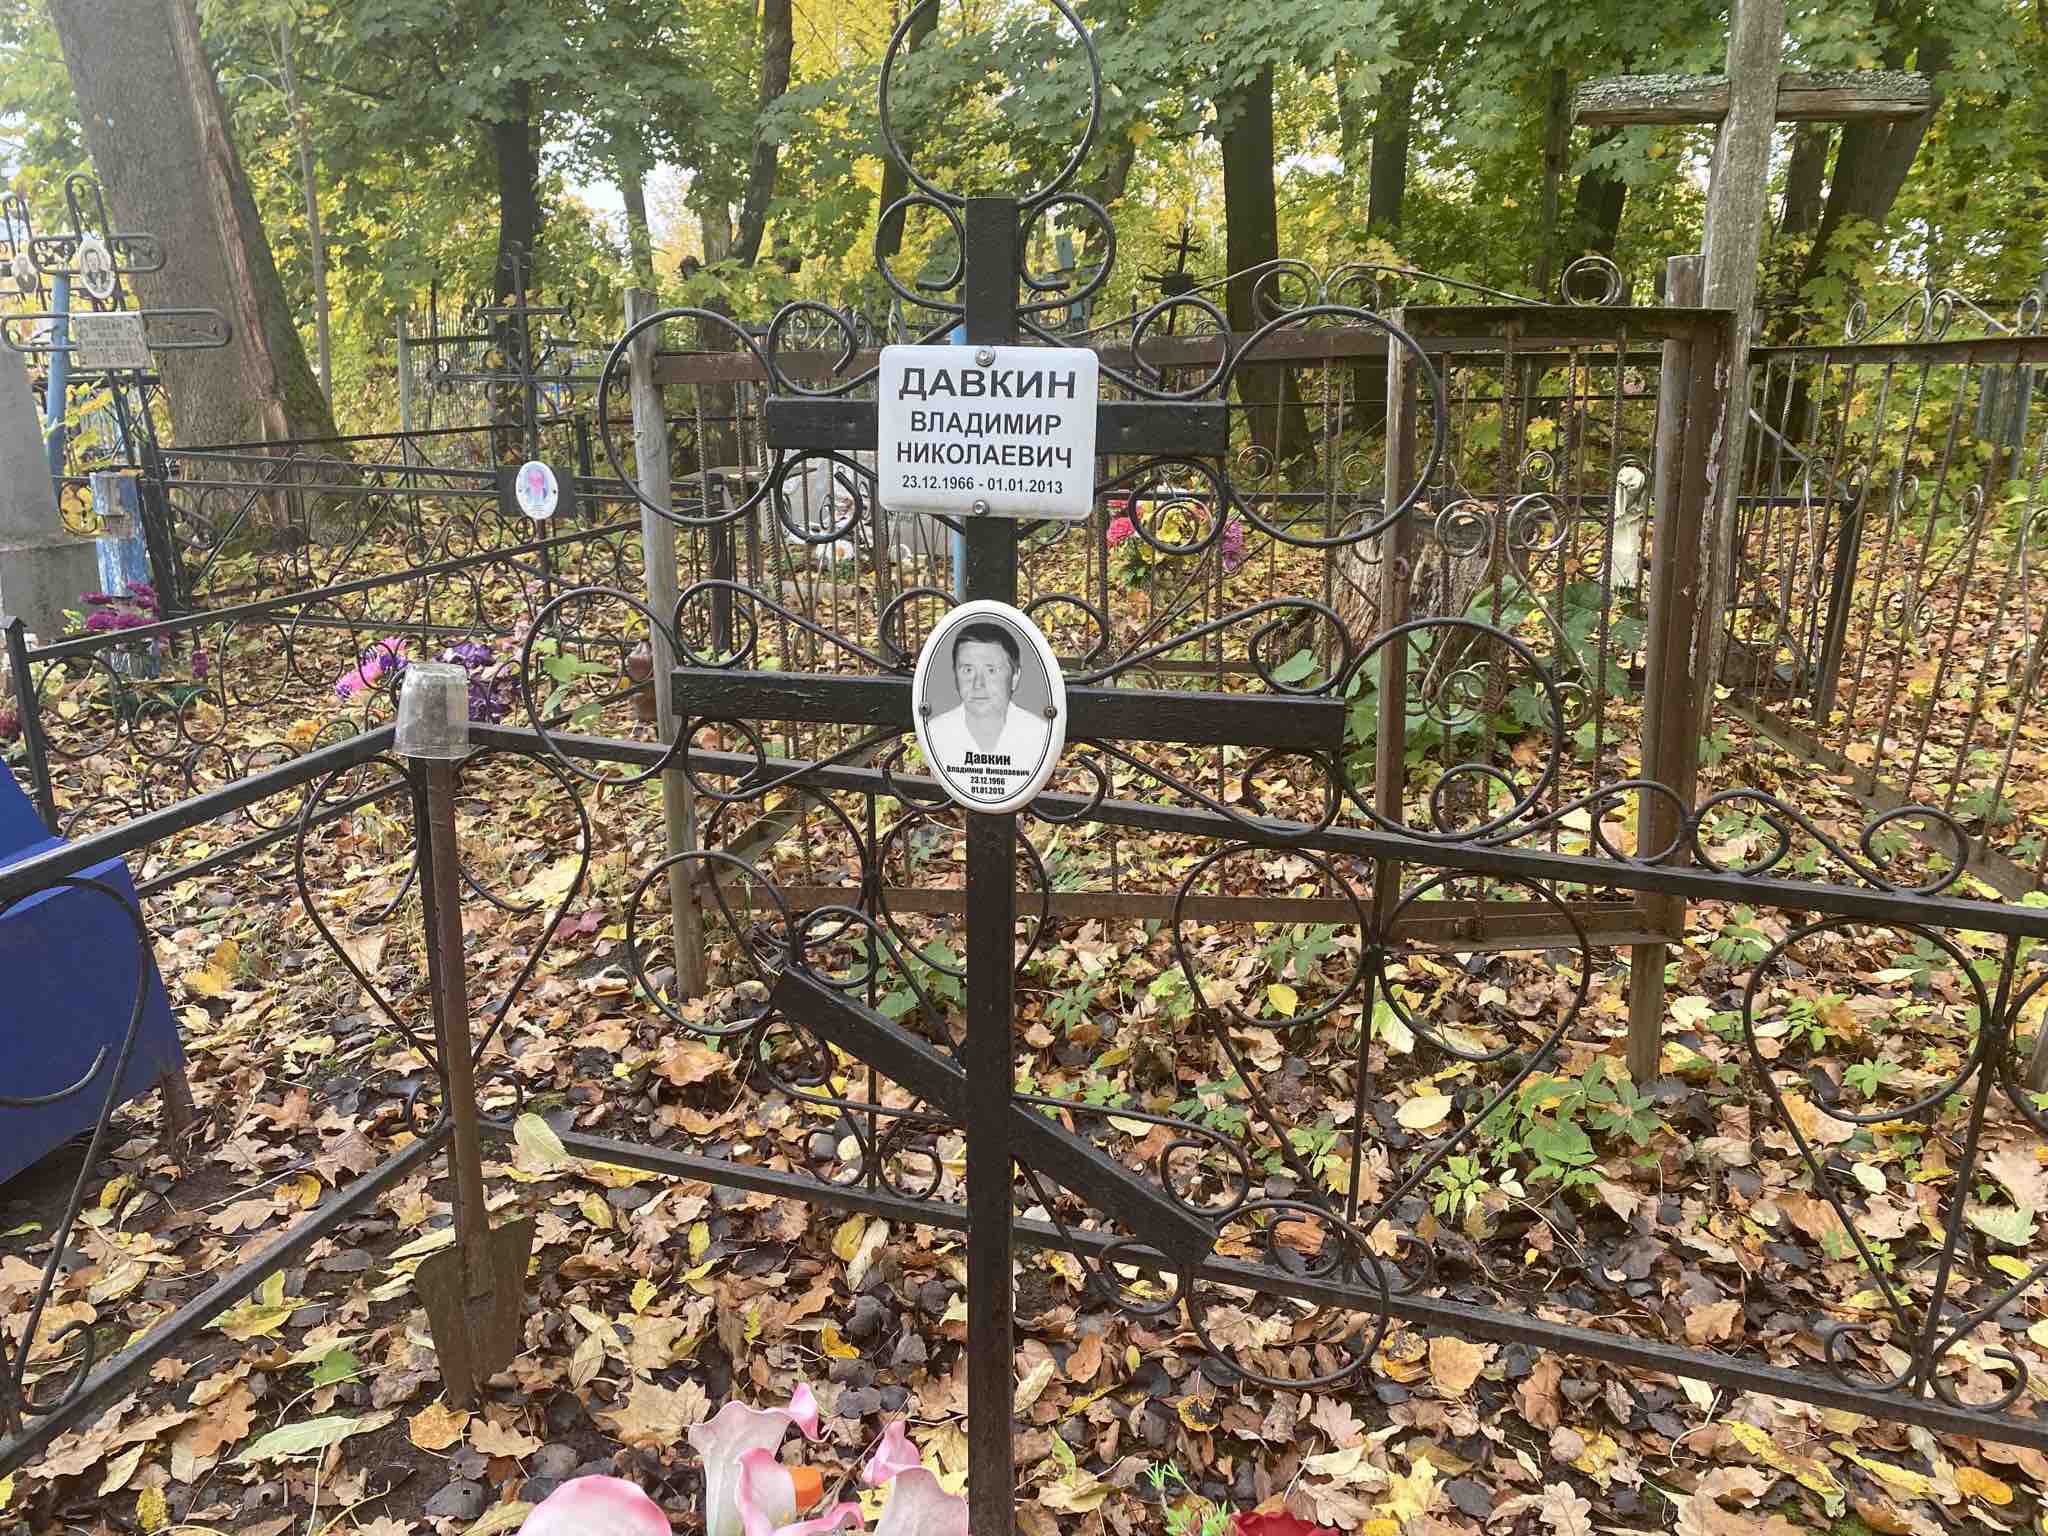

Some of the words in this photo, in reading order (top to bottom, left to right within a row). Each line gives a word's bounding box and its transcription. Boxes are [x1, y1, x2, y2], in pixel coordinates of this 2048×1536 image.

[898, 367, 1076, 401] ДАВКИН
[911, 411, 1062, 438] ВЛАДИМИР
[897, 442, 1072, 468] НИКОЛАЕВИЧ
[902, 474, 974, 490] 23.12.1966
[987, 477, 1063, 494] 01.01.2013
[964, 751, 1011, 765] Давкин
[970, 776, 1006, 785] 23.12.1966
